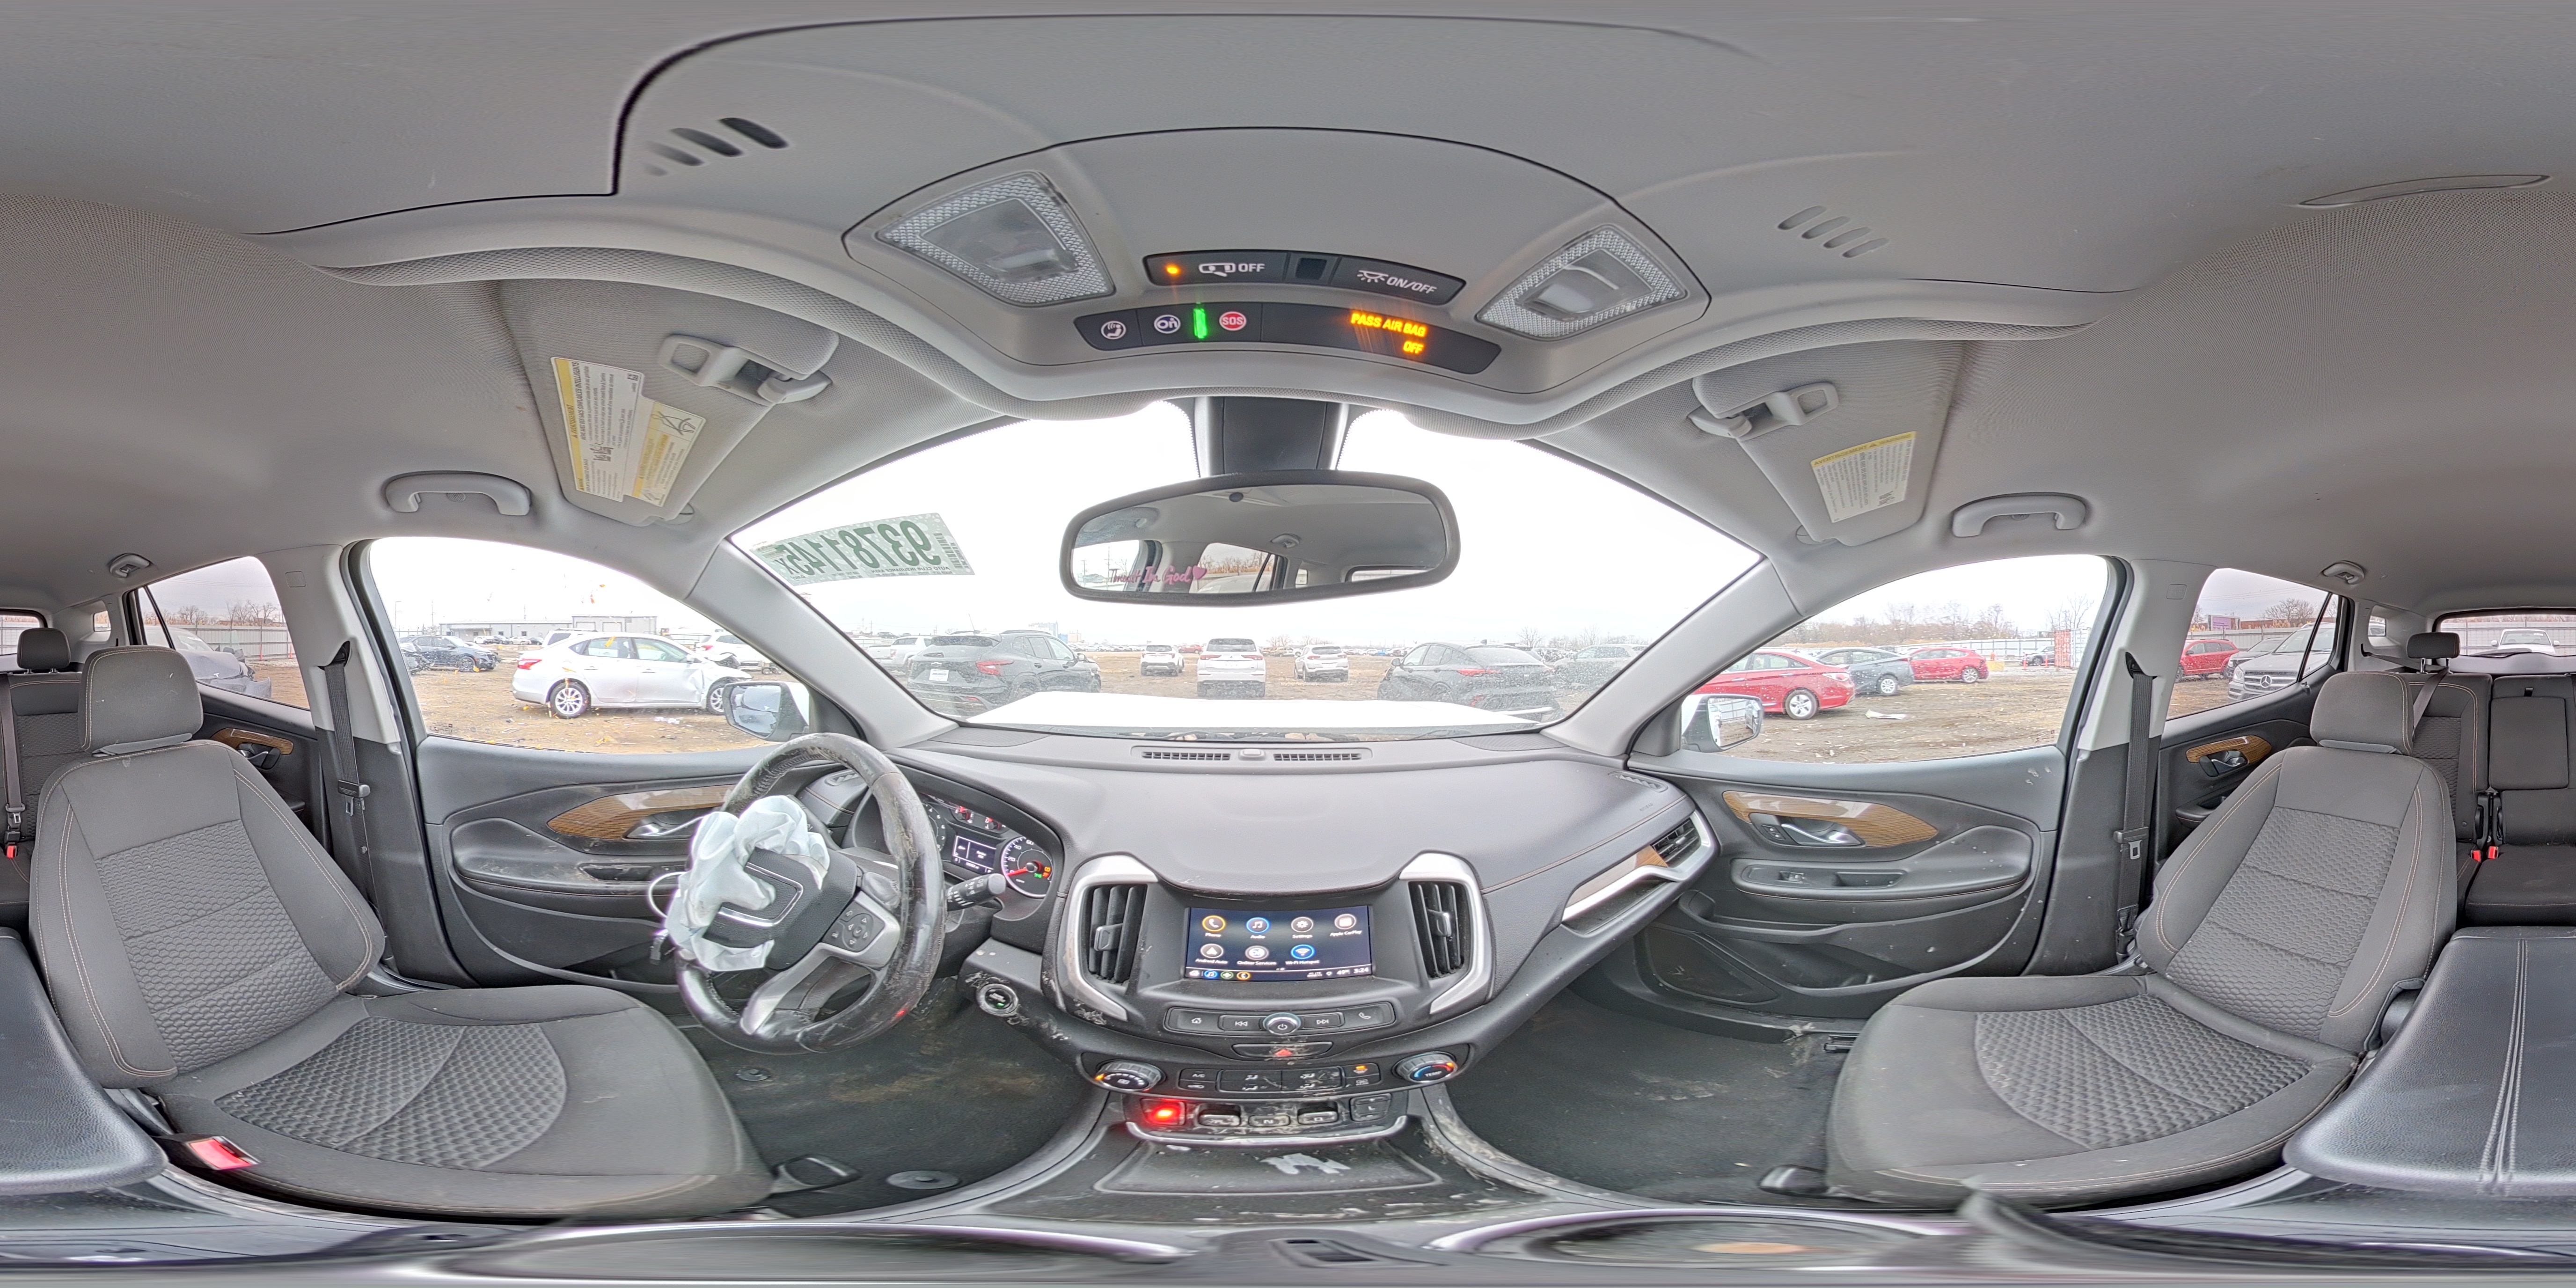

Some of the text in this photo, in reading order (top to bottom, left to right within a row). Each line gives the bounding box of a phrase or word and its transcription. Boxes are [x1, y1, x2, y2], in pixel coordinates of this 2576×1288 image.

[1238, 263, 1265, 272] OFF
[1386, 277, 1437, 294] ON/OFF
[1222, 317, 1243, 325] SOS
[1351, 313, 1426, 337] PASS AIR BAG
[1403, 341, 1424, 354] OFF
[1162, 565, 1193, 585] God
